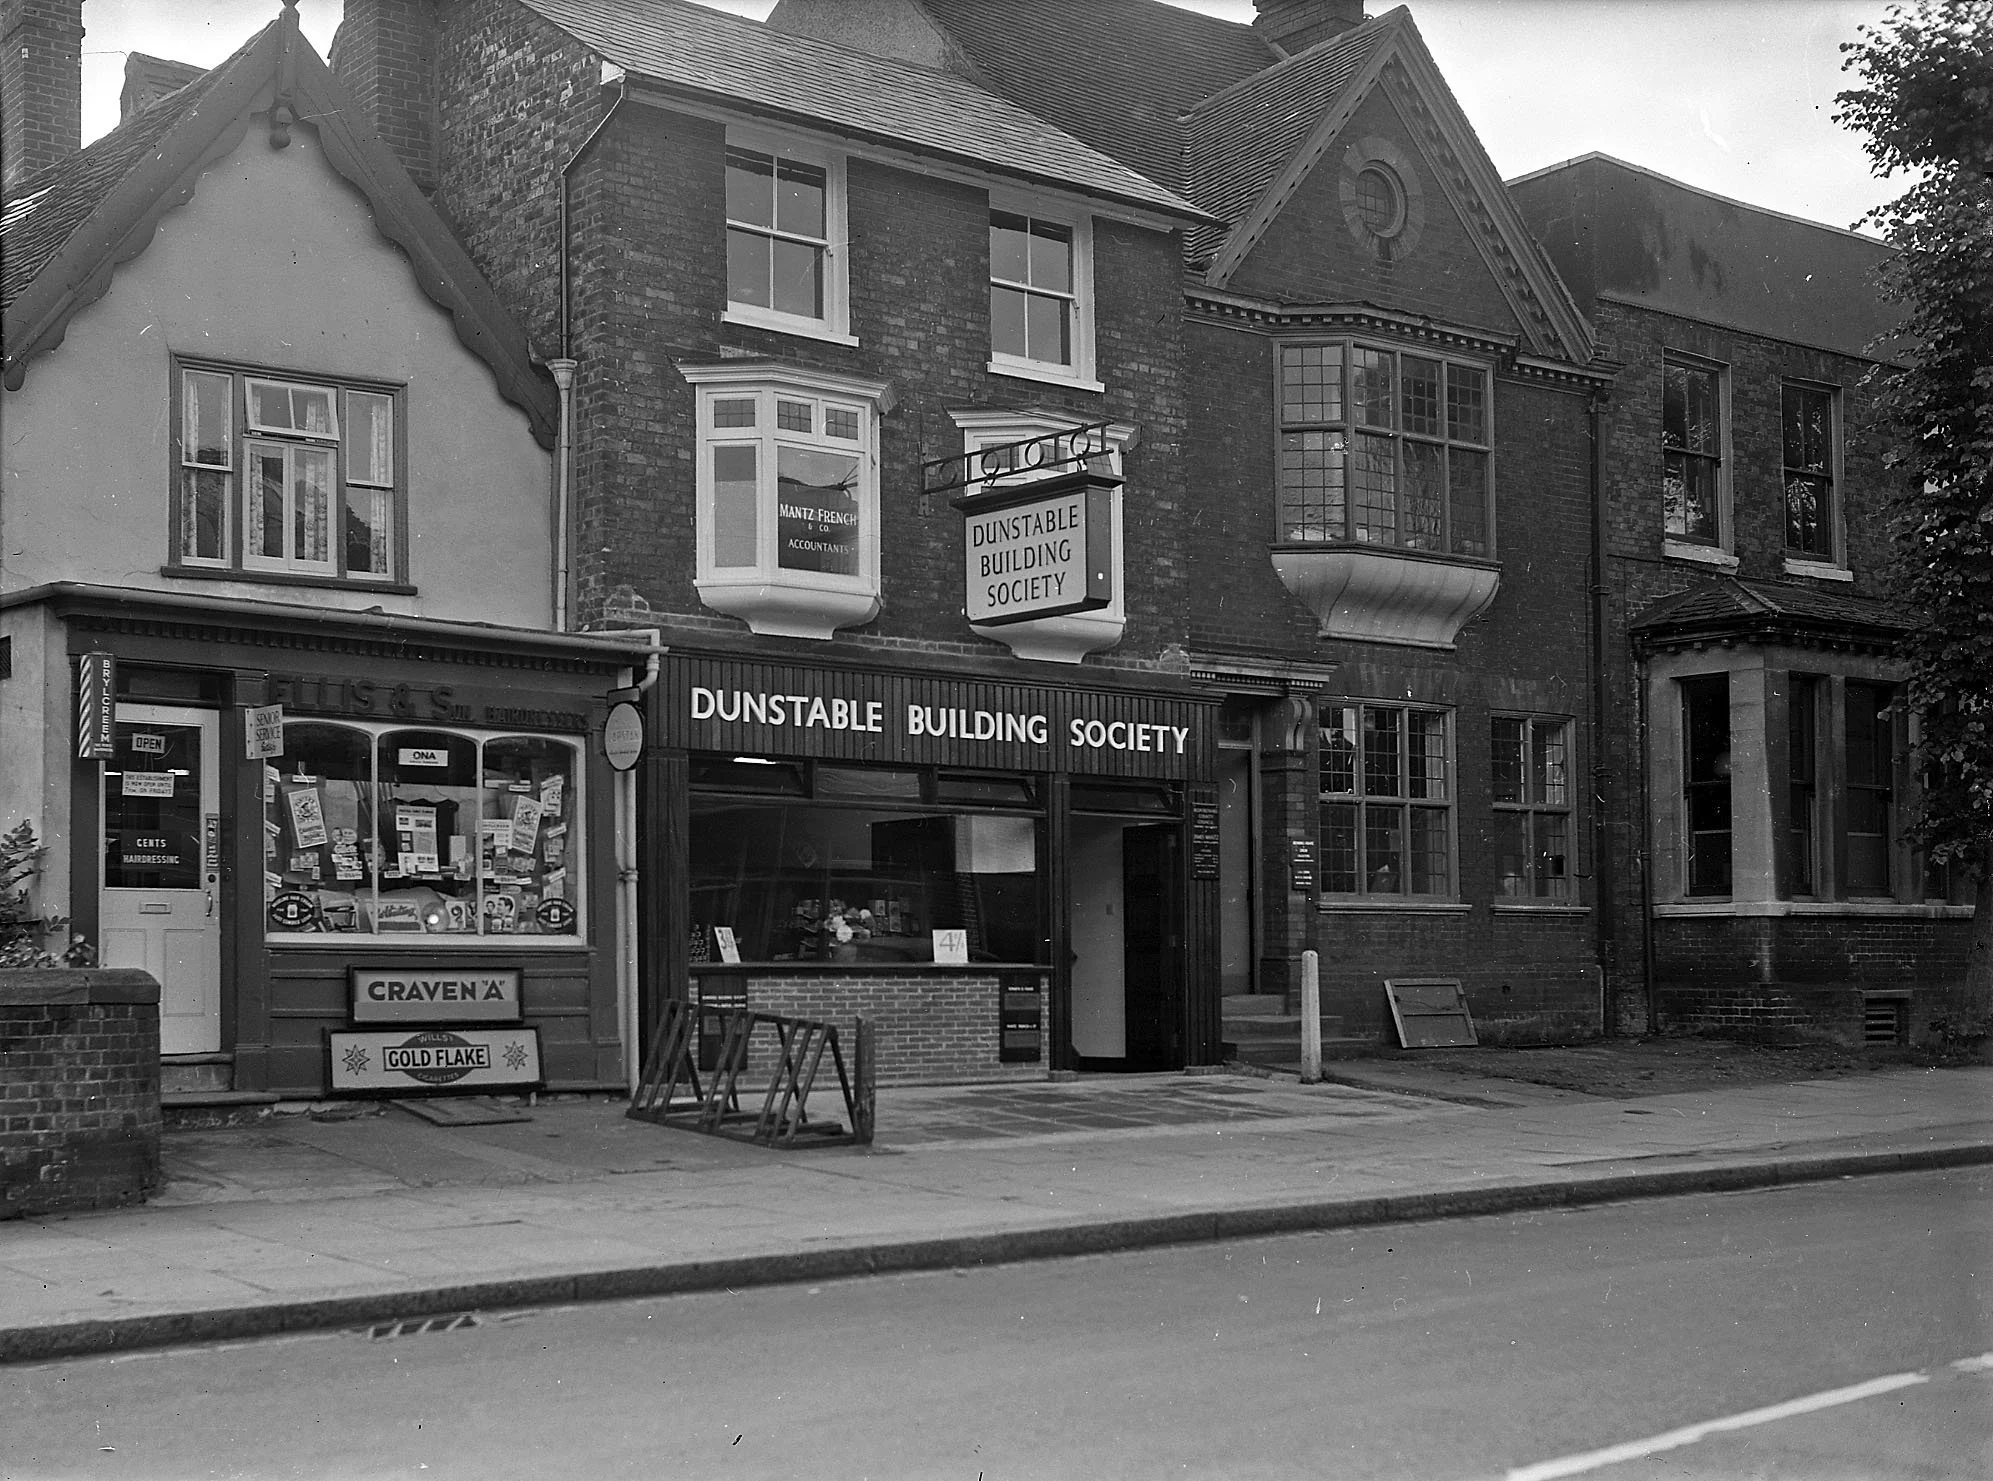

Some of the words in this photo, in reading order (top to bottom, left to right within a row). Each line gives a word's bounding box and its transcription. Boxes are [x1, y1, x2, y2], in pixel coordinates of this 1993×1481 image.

[779, 503, 814, 521] MANTZ
[818, 508, 857, 526] FRENCH
[973, 505, 1078, 547] DUNSTABLE
[788, 538, 849, 554] ACCOUNTANTS
[981, 539, 1071, 578] BUILDING
[988, 571, 1067, 607] SOCIETY
[101, 659, 111, 743] BRYLCREEM
[269, 673, 376, 714] ELLIS
[391, 683, 415, 718] &
[256, 711, 281, 726] SENIOR
[690, 687, 884, 734] DUNSTABLE
[908, 704, 1048, 746] BUILDING
[1069, 717, 1190, 755] SOCIETY
[136, 737, 162, 750] OPEN
[256, 726, 281, 741] SERVICE
[413, 751, 437, 760] ONA
[368, 981, 477, 1001] CRAVEN
[388, 1050, 431, 1067] GOLD
[436, 1048, 485, 1067] FLAKE
